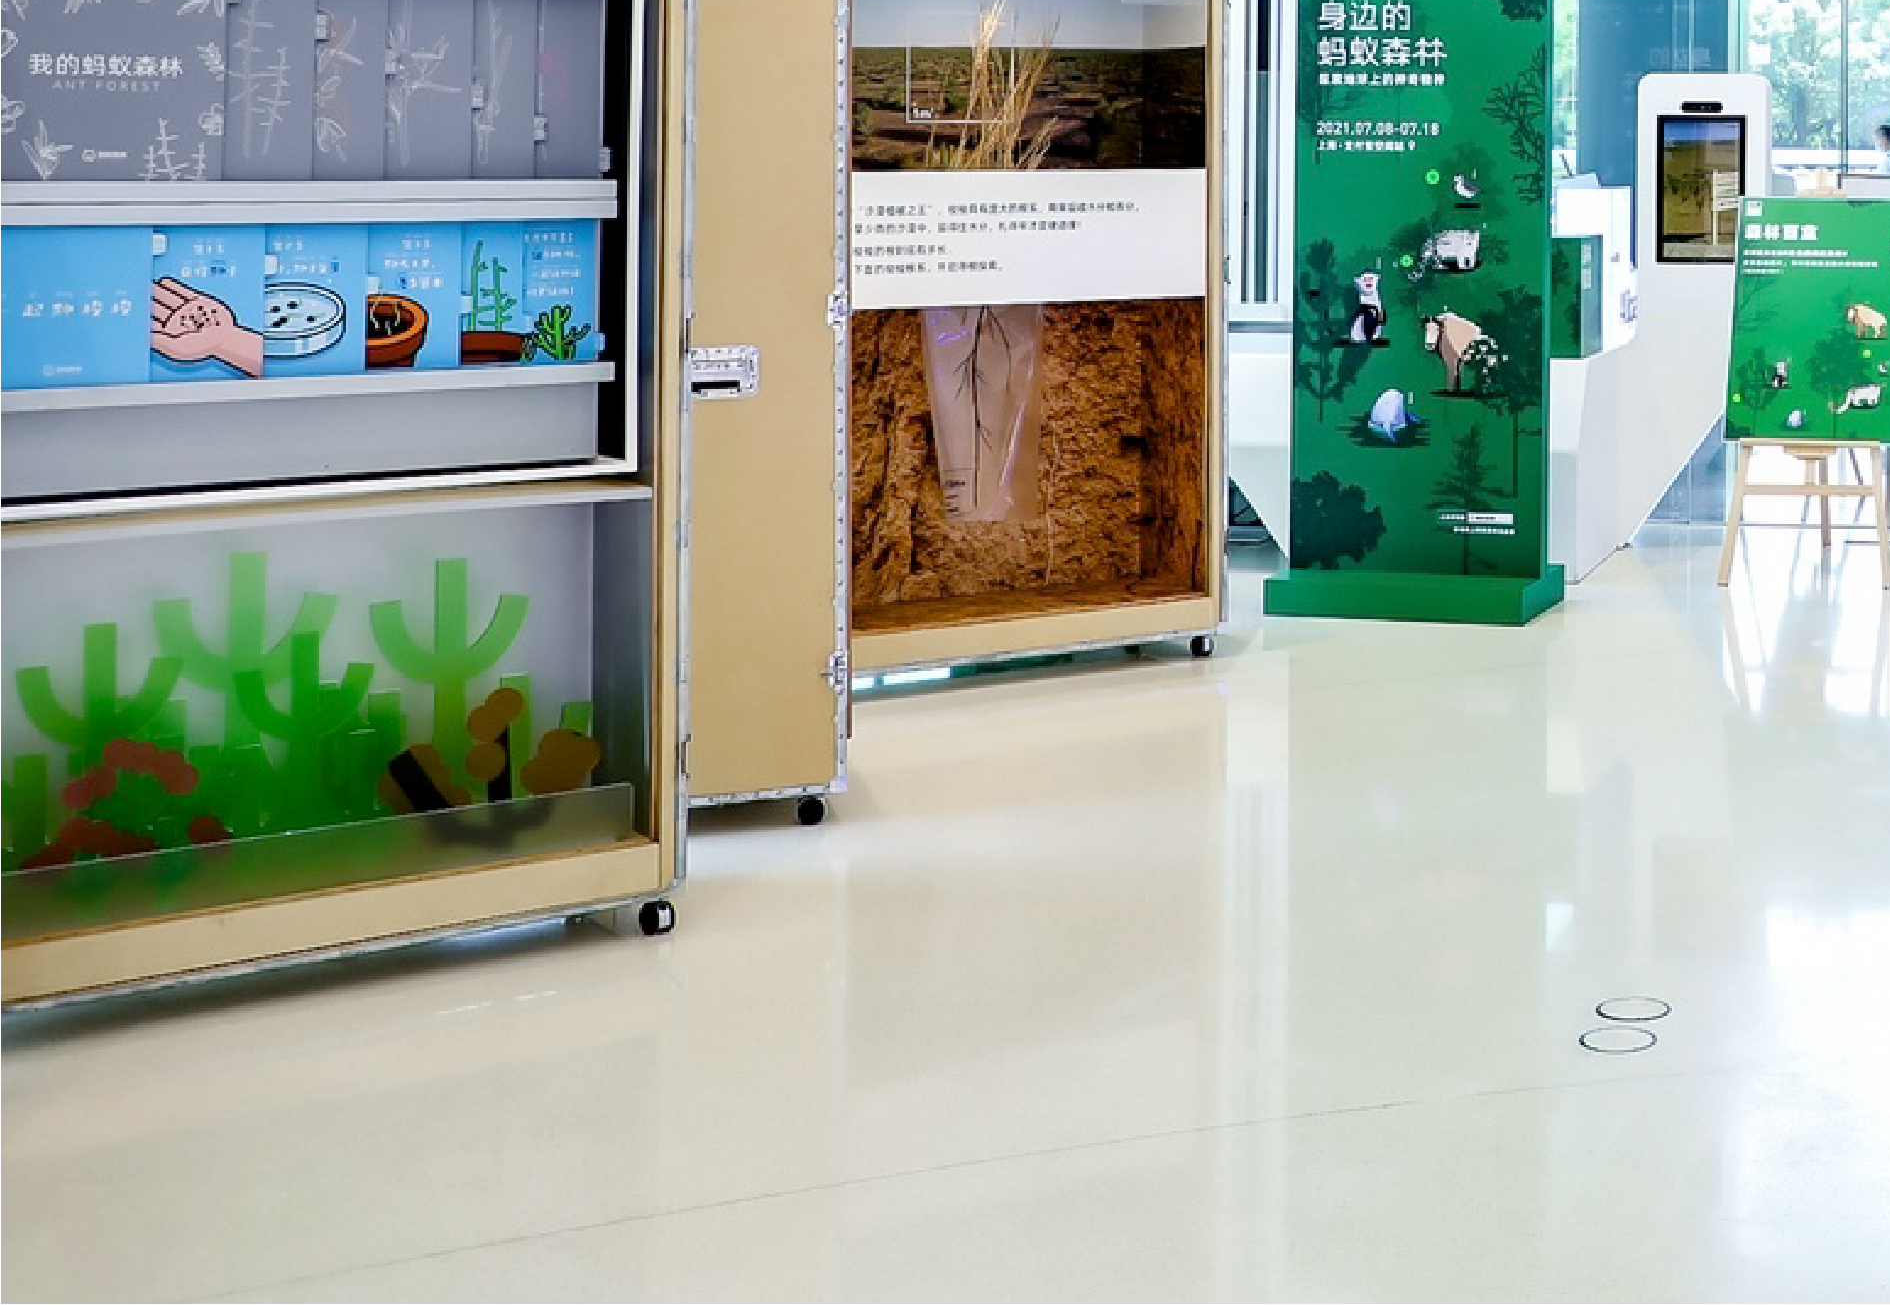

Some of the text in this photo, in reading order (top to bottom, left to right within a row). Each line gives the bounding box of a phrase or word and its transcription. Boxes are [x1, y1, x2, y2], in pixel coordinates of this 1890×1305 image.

[1317, 0, 1411, 31] 身边的
[28, 52, 184, 78] 我的蚂蚁森林
[1317, 37, 1448, 67] 蚂蚁森林
[52, 80, 161, 92] ANT FOREST
